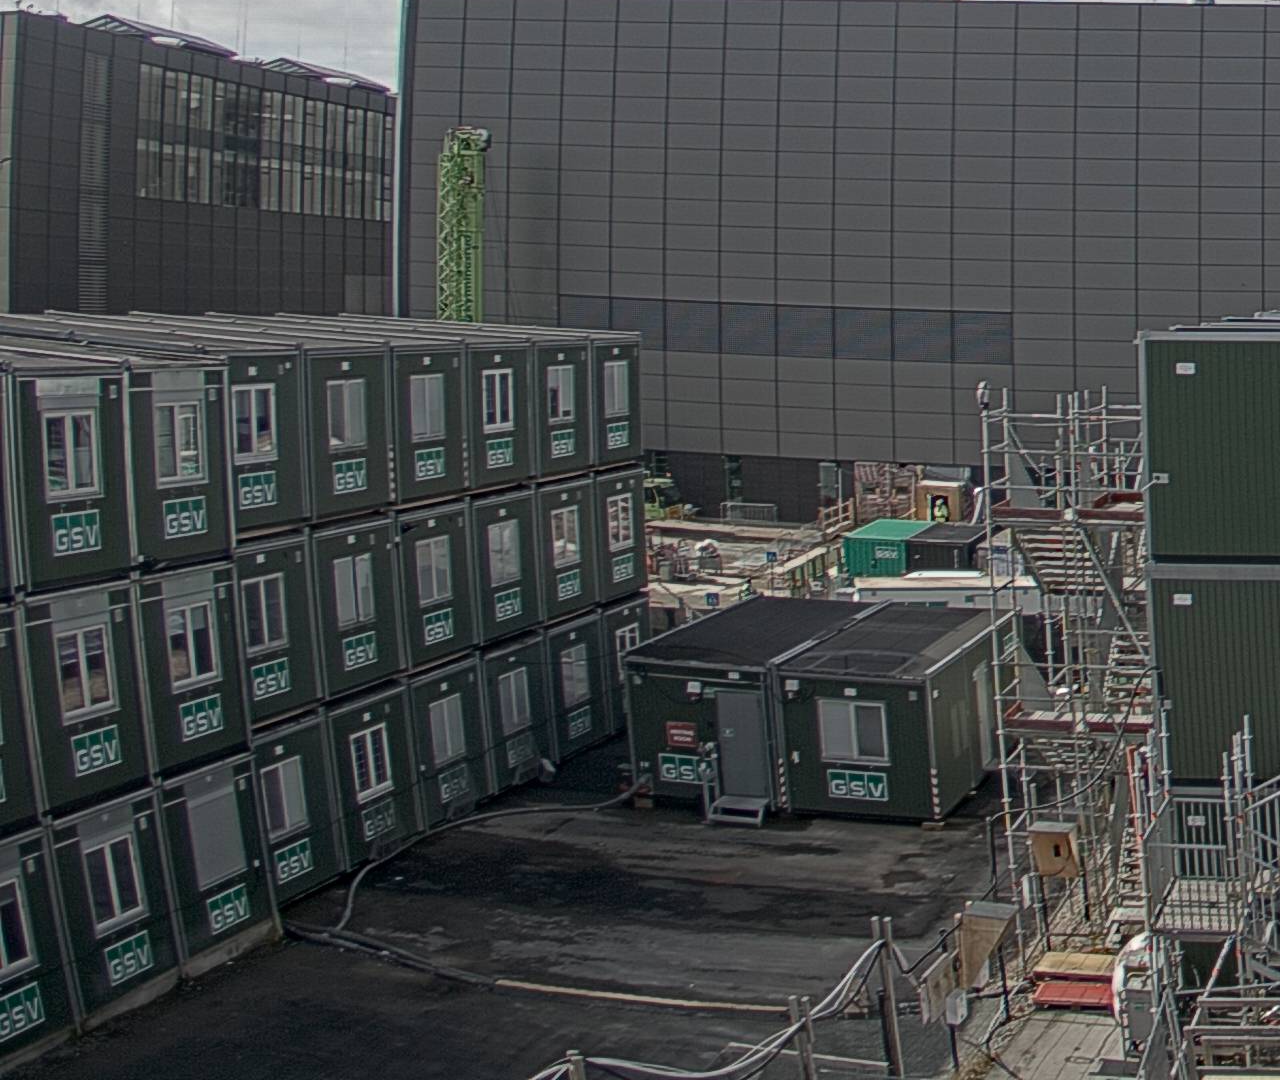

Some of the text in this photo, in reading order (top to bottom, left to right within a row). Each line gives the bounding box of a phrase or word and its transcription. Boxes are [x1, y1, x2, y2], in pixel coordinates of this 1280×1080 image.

[417, 458, 444, 477] GSV
[488, 448, 513, 465] GSV
[336, 469, 365, 489] GSV
[241, 483, 274, 505] GSV
[167, 510, 204, 533] GSV
[56, 524, 98, 550] GSV
[497, 598, 521, 618] GSV
[426, 619, 453, 640] GSV
[346, 644, 376, 665] GSV
[255, 670, 288, 695] GSV
[184, 708, 221, 735] GSV
[76, 740, 117, 770] GSV
[829, 778, 884, 799] GSV
[366, 812, 392, 836] GSV
[279, 852, 310, 878] GSV
[212, 898, 245, 928] GSV
[111, 945, 149, 979] GSV
